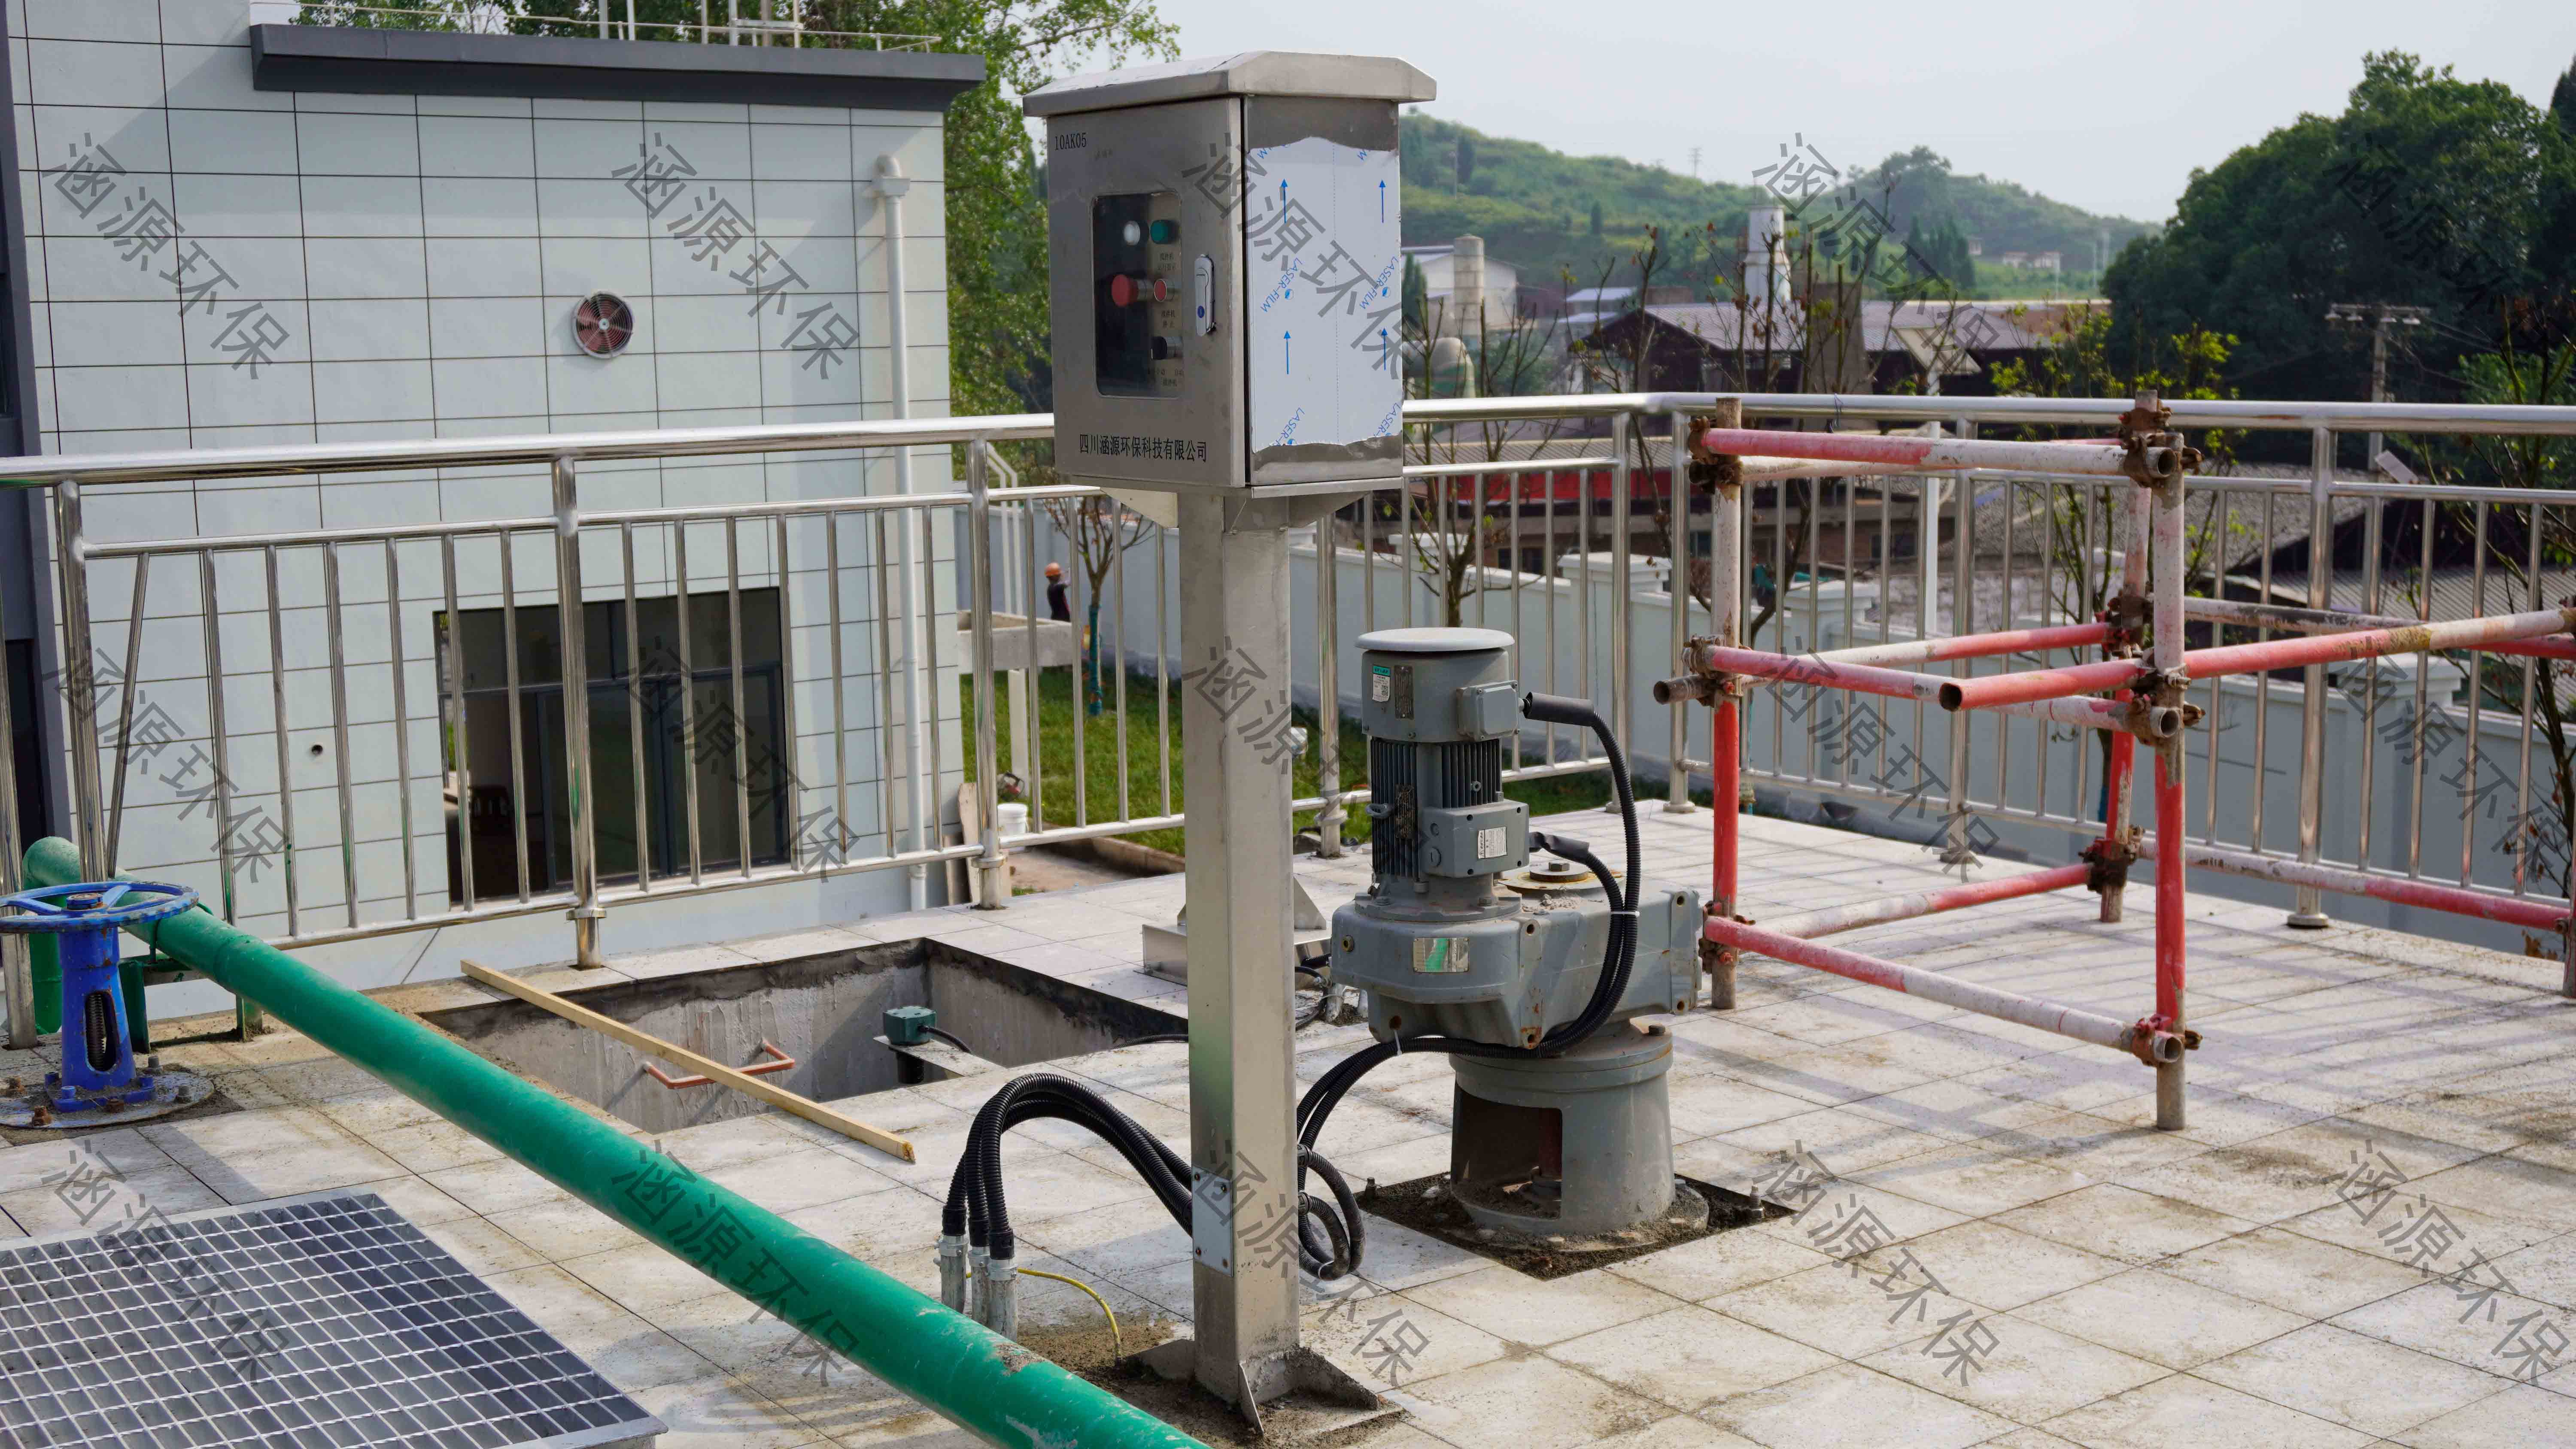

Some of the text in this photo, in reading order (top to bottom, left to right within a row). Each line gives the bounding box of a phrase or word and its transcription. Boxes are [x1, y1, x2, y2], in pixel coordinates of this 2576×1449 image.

[1260, 257, 1303, 313] LASER-FILM
[1359, 256, 1399, 310] LASER-FILM
[1373, 402, 1401, 437] LASER-
[1079, 433, 1207, 463] 四川涵源环保科技有限公司
